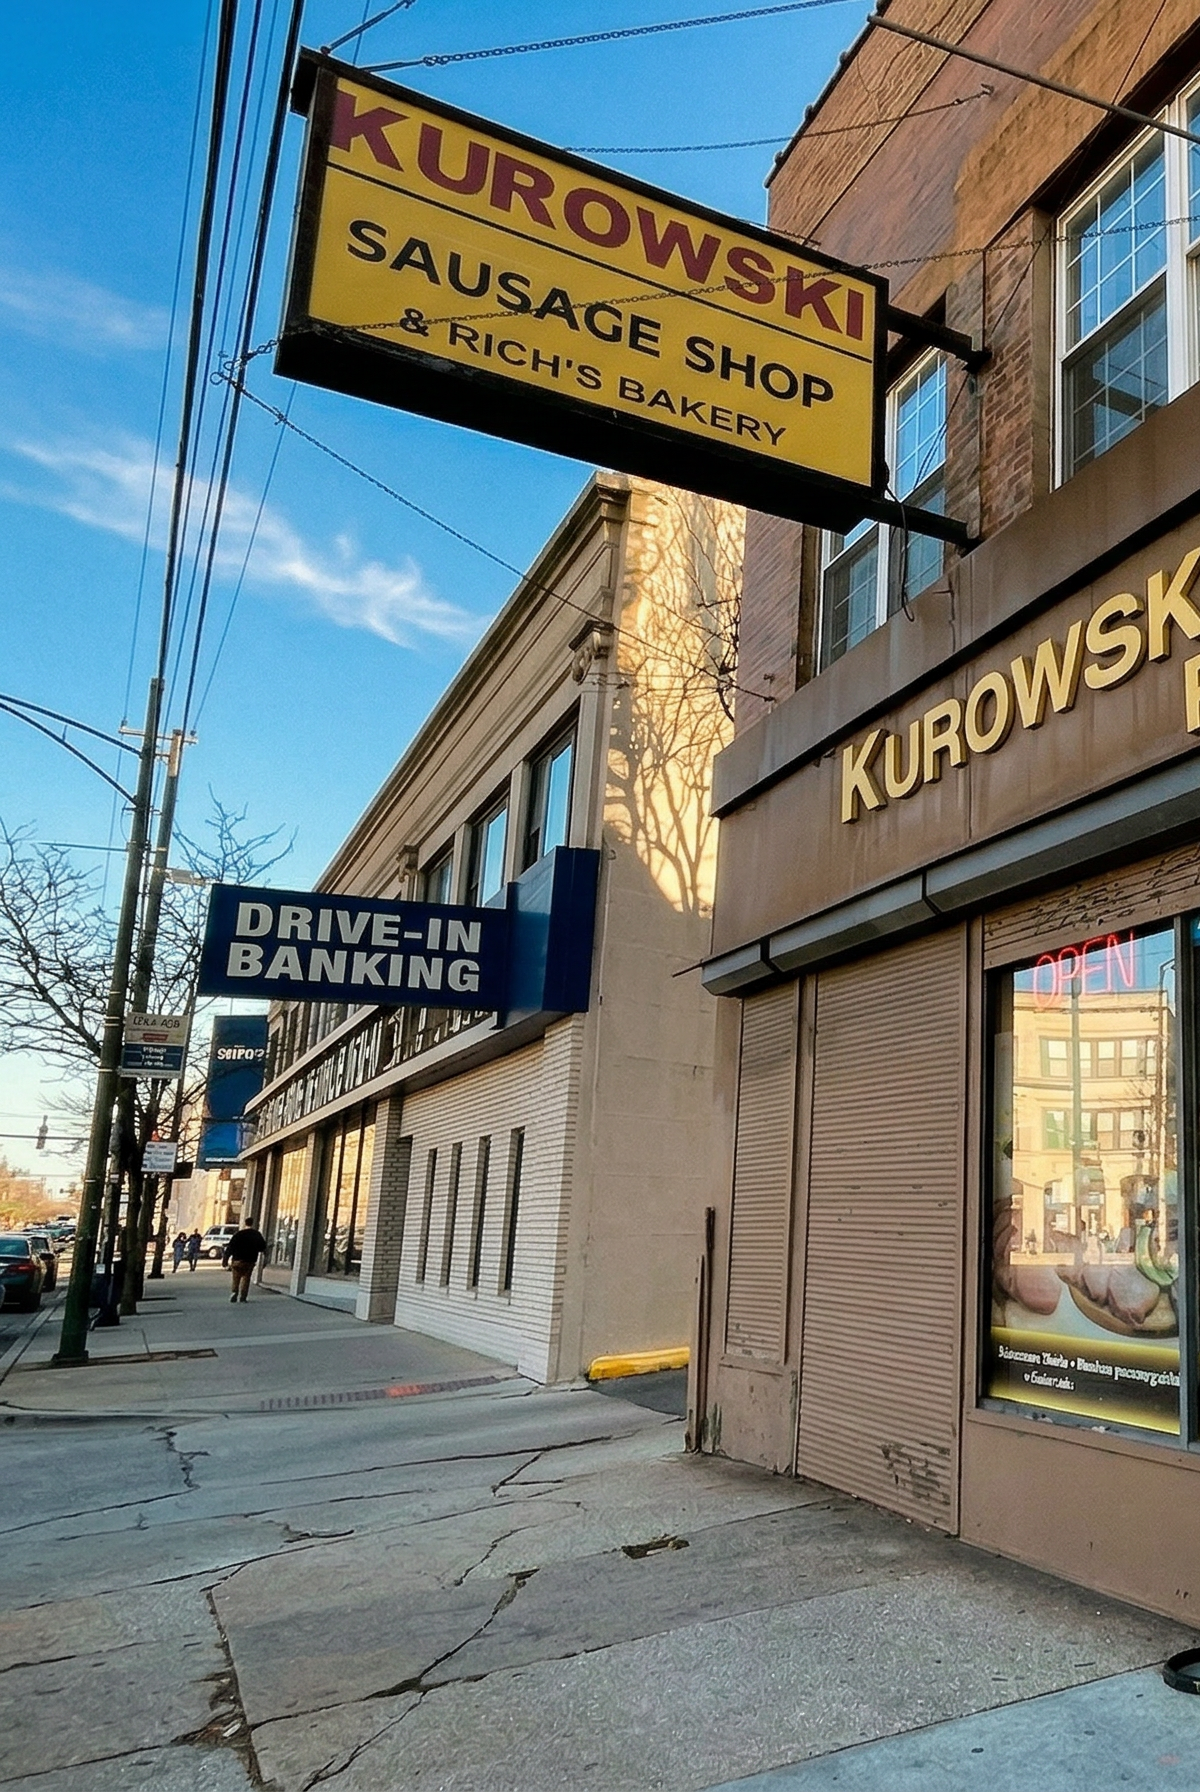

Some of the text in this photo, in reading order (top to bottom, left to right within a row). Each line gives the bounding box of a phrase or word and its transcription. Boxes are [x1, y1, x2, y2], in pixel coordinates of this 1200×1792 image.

[328, 91, 865, 342] KUROWSKI
[347, 219, 835, 408] SAUSAGE SHOP
[399, 307, 786, 447] & RICH'S BAKERY
[226, 942, 481, 993] BANKING
[235, 901, 482, 954] DRIVE-IN
[1032, 929, 1135, 1012] OPEN
